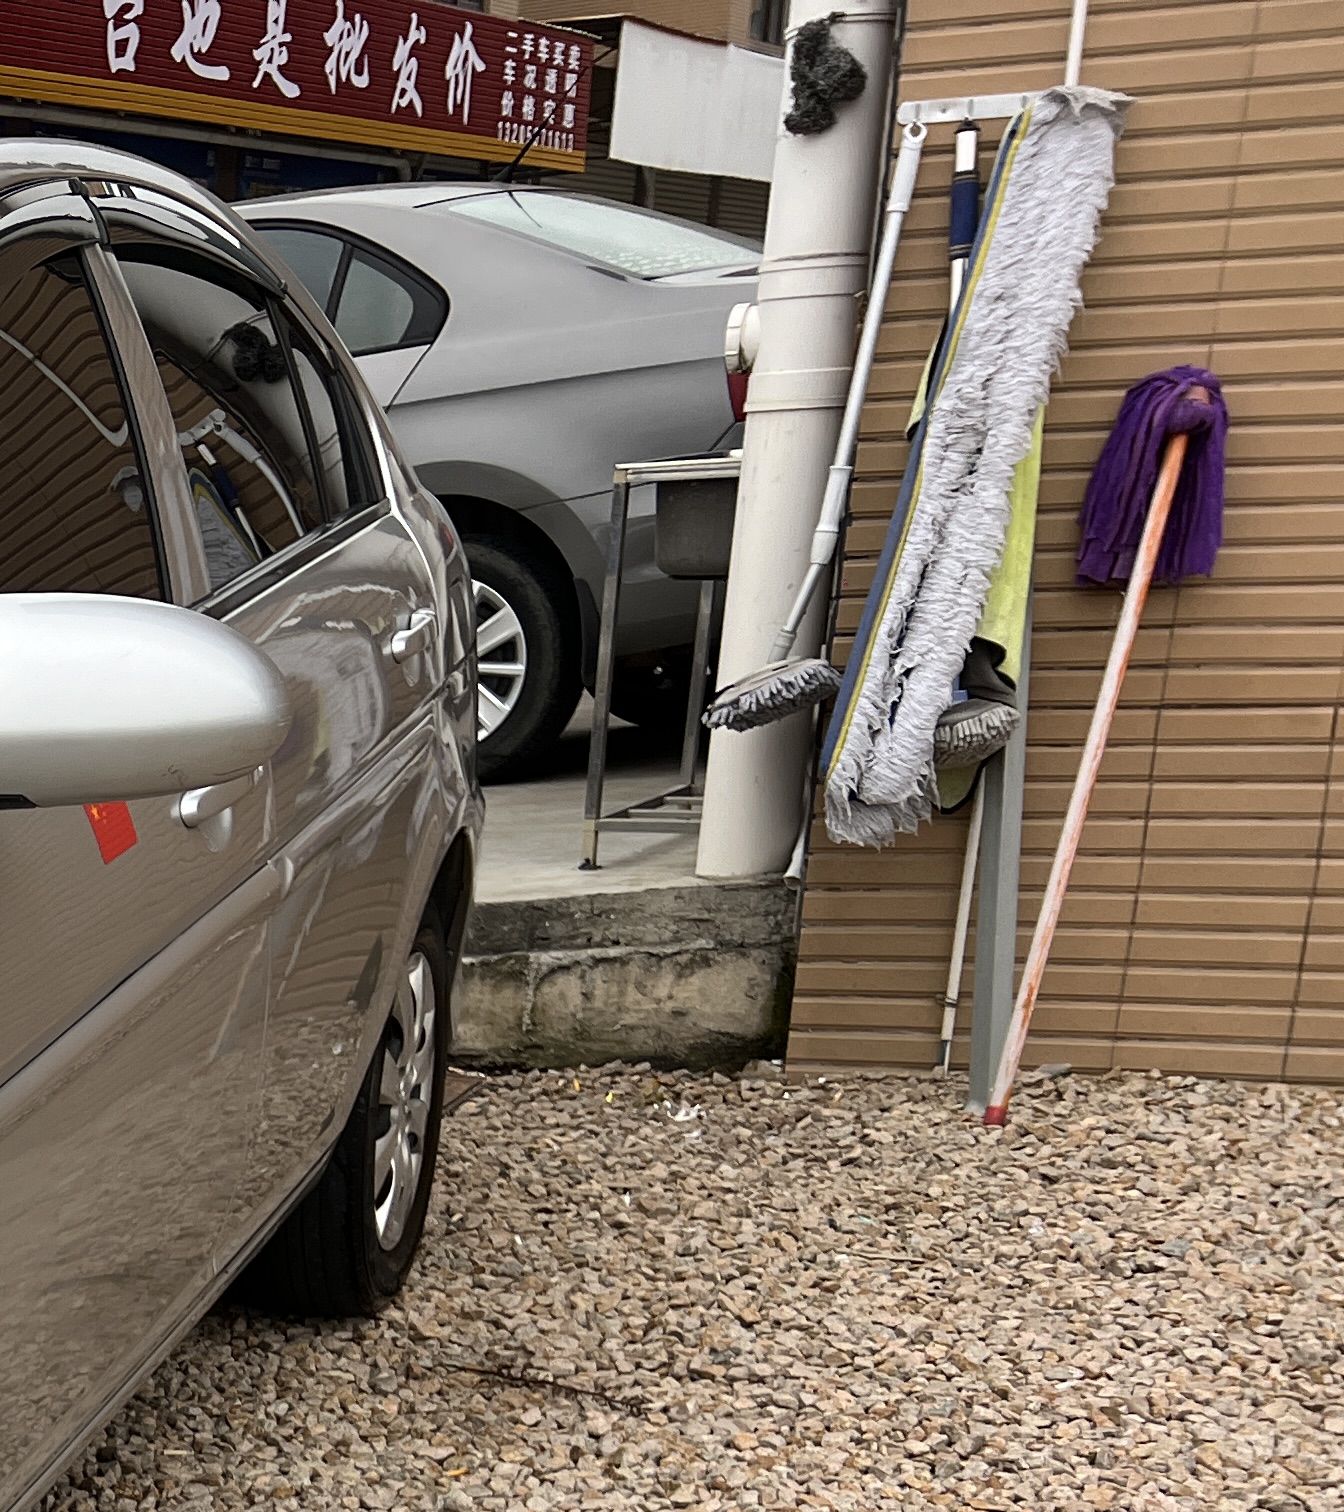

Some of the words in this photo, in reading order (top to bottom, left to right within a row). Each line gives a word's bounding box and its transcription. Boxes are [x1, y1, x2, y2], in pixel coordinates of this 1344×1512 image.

[504, 30, 581, 71] 二手车买卖
